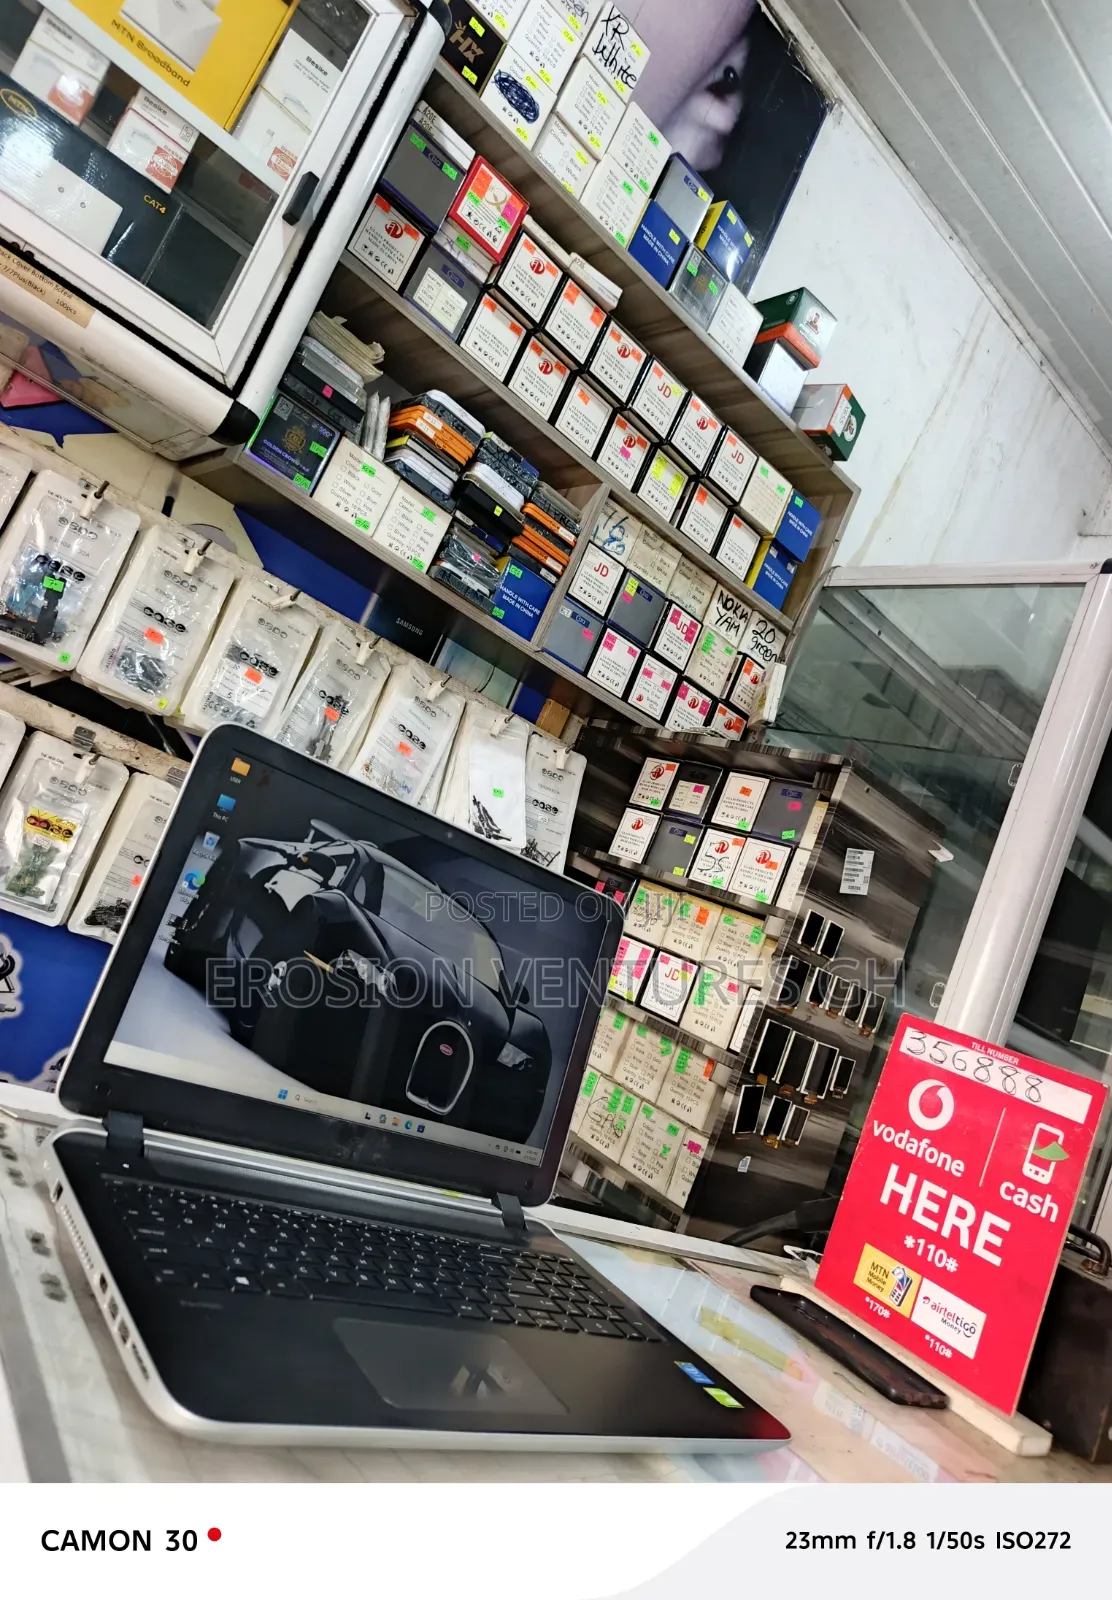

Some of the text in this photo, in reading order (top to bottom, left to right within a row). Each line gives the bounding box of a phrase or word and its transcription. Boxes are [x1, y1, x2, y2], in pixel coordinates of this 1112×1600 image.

[112, 19, 190, 88] MTN Broadband
[306, 56, 328, 76] Besike
[144, 96, 167, 115] Besike
[422, 106, 436, 123] A20E
[553, 121, 568, 138] Model
[144, 195, 166, 213] CAT4
[641, 224, 675, 264] HANDLE WITH CARE
[643, 234, 654, 248] MADE
[657, 250, 669, 265] CHINA
[12, 258, 30, 272] Cover
[32, 270, 54, 287] Bottom
[54, 285, 73, 299] Screw
[56, 299, 77, 315] 100pcs
[657, 382, 672, 398] JD
[731, 450, 744, 464] JD
[594, 562, 609, 578] JD
[500, 584, 540, 616] HANDLE WITH CARE
[502, 593, 515, 606] MADE
[519, 605, 533, 619] CHINA
[143, 606, 187, 632] case
[396, 617, 424, 636] SAMSUNG
[752, 620, 776, 643] 20
[750, 636, 777, 662] green
[239, 651, 279, 676] case
[398, 723, 426, 751] case
[230, 776, 242, 784] USER
[532, 799, 558, 815] case
[26, 815, 74, 838] case
[664, 967, 680, 982] JD
[971, 1042, 1020, 1065] TILL NUMBER
[906, 1030, 1043, 1103] 356888
[873, 1120, 965, 1178] vodafone
[1000, 1182, 1059, 1223] cash
[880, 1163, 1011, 1267] HERE
[868, 1271, 886, 1286] Mobile
[870, 1262, 890, 1279] MTN
[866, 1277, 884, 1292] Money
[931, 1302, 978, 1335] airteltigo
[941, 1318, 962, 1334] Money
